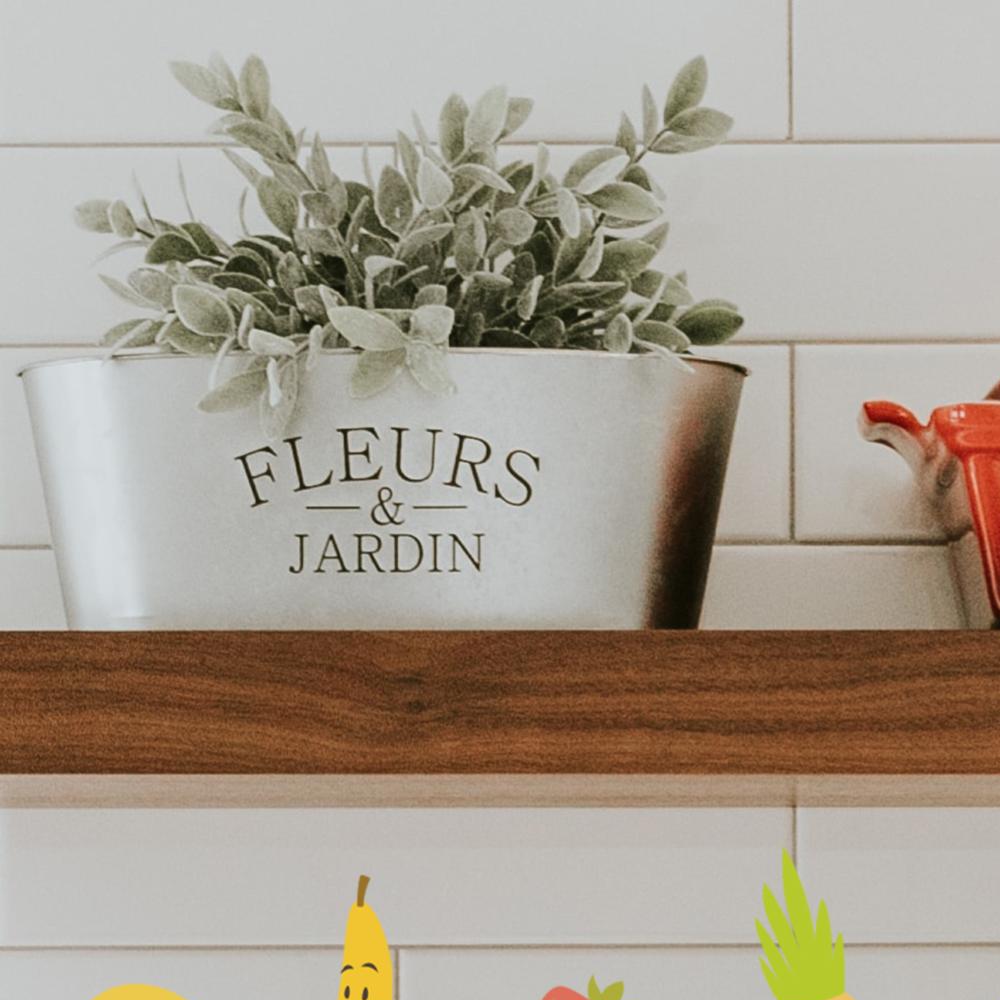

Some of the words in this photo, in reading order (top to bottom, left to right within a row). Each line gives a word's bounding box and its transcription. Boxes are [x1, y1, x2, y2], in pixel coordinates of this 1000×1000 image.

[234, 426, 540, 508] FLEURS
[370, 486, 405, 526] &
[289, 533, 486, 574] JARDIN
